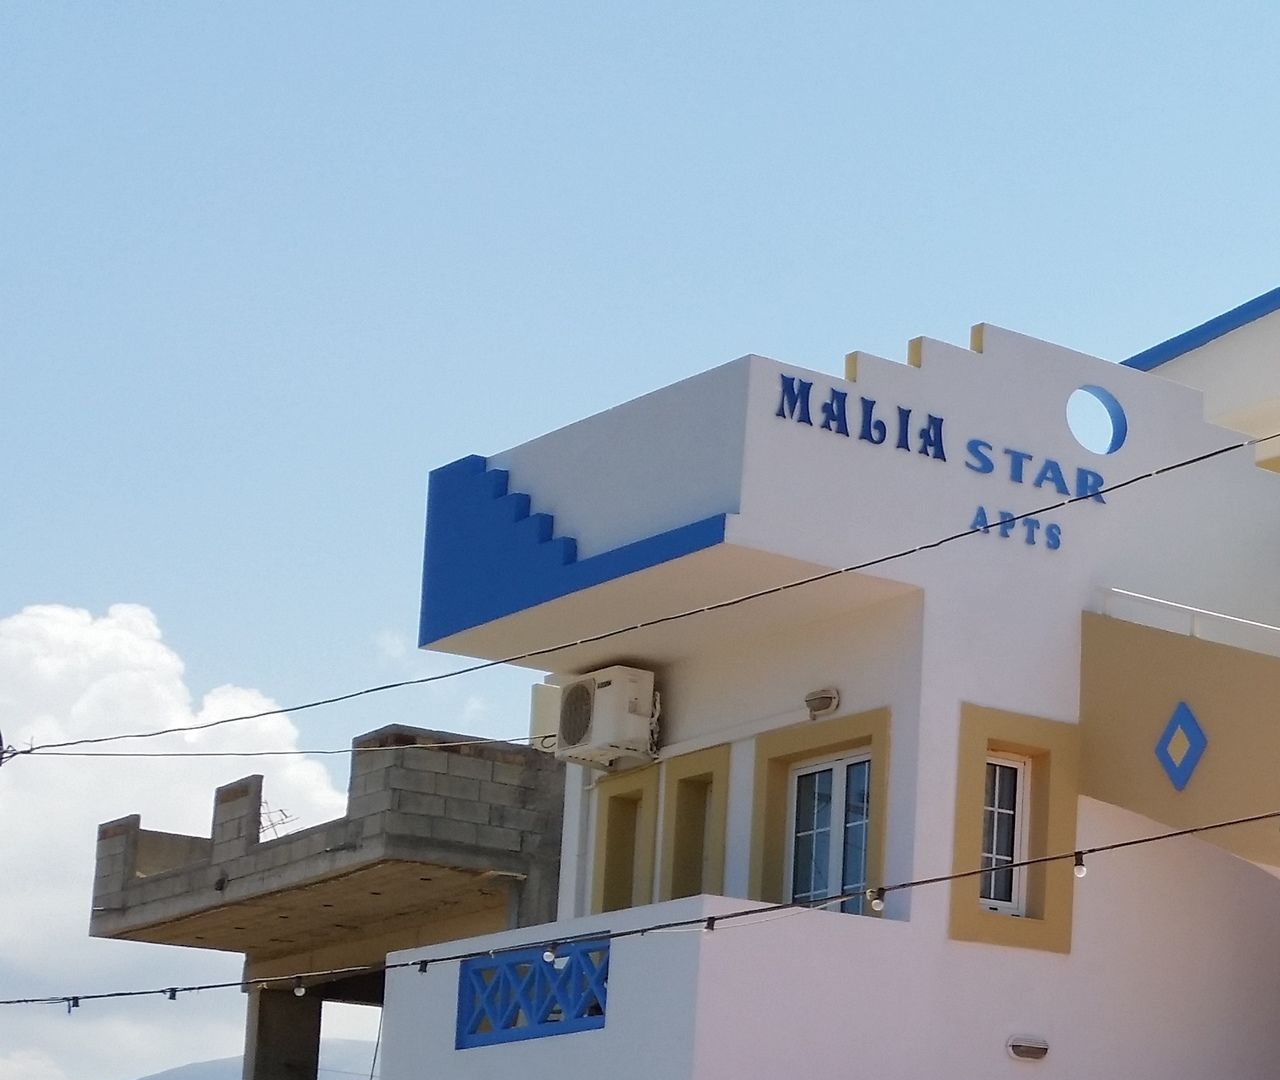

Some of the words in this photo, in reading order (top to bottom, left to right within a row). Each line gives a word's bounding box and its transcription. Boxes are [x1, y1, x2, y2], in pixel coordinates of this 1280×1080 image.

[775, 373, 947, 462] MALIA
[965, 438, 1107, 504] STAR
[970, 505, 1062, 550] APTS
